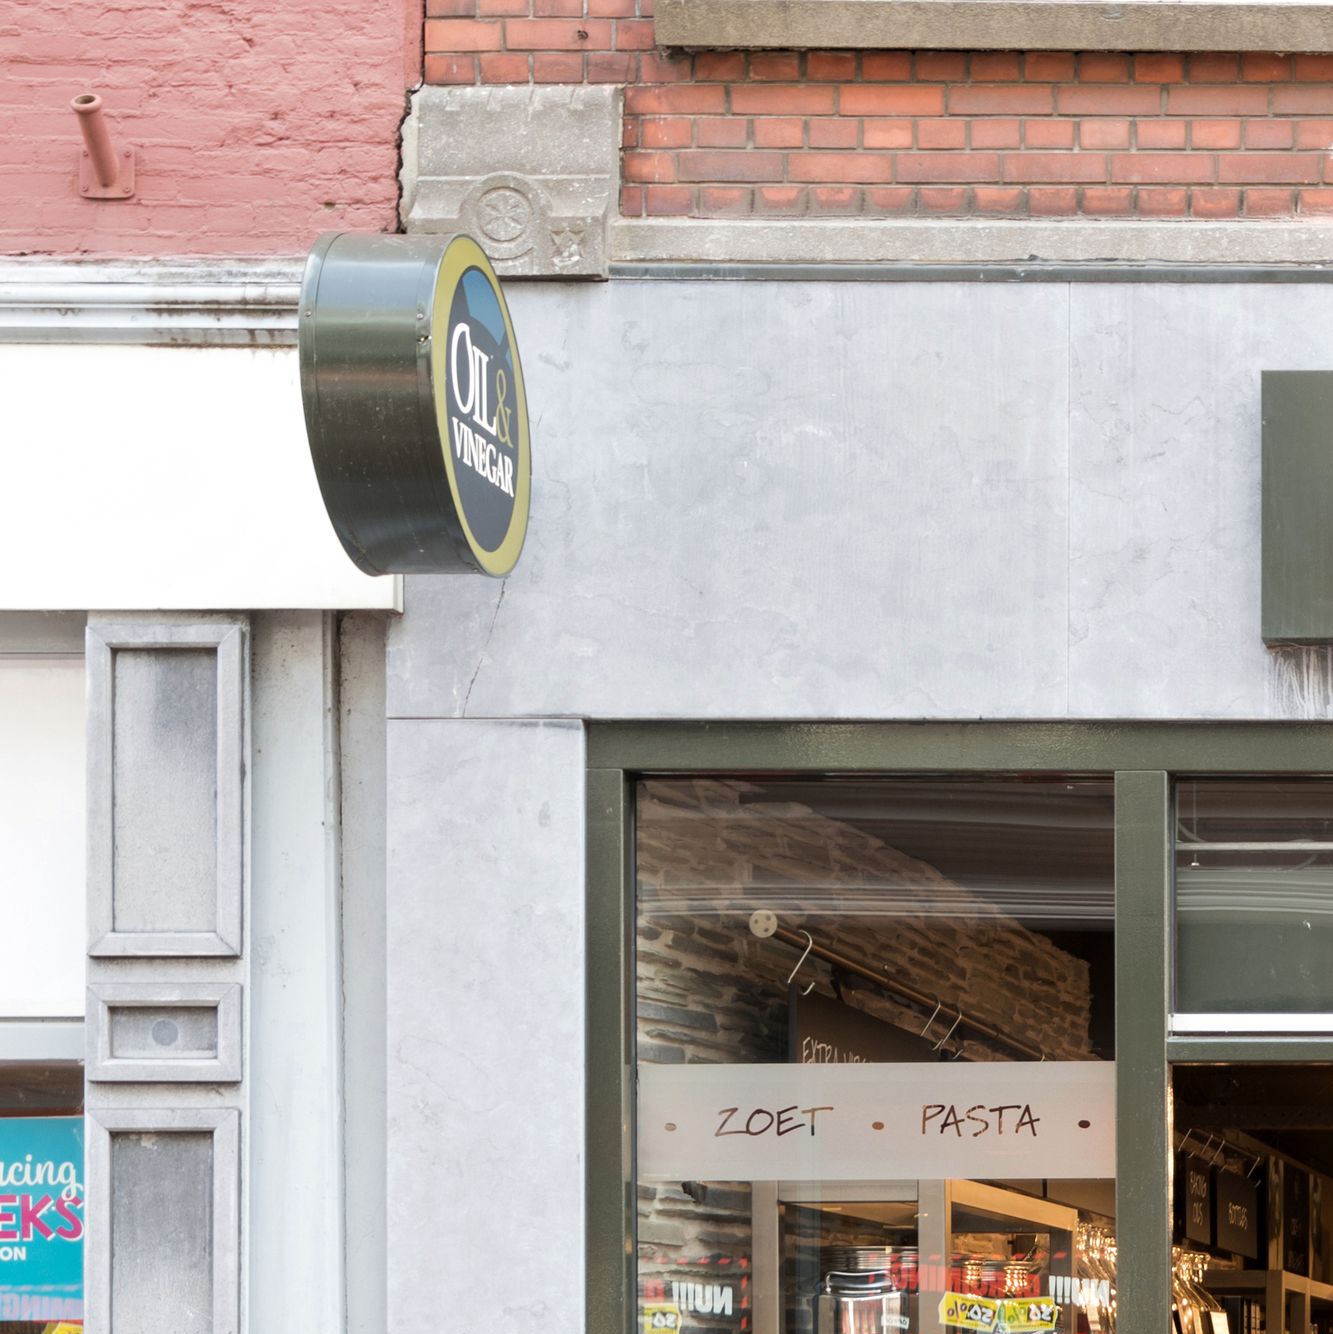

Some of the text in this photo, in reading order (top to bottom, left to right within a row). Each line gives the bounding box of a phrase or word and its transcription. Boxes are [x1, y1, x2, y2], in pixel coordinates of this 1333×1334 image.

[451, 323, 514, 448] OIL&
[451, 416, 514, 498] VINEGAR
[715, 1106, 834, 1137] ZOET
[921, 1104, 1040, 1138] PASTA
